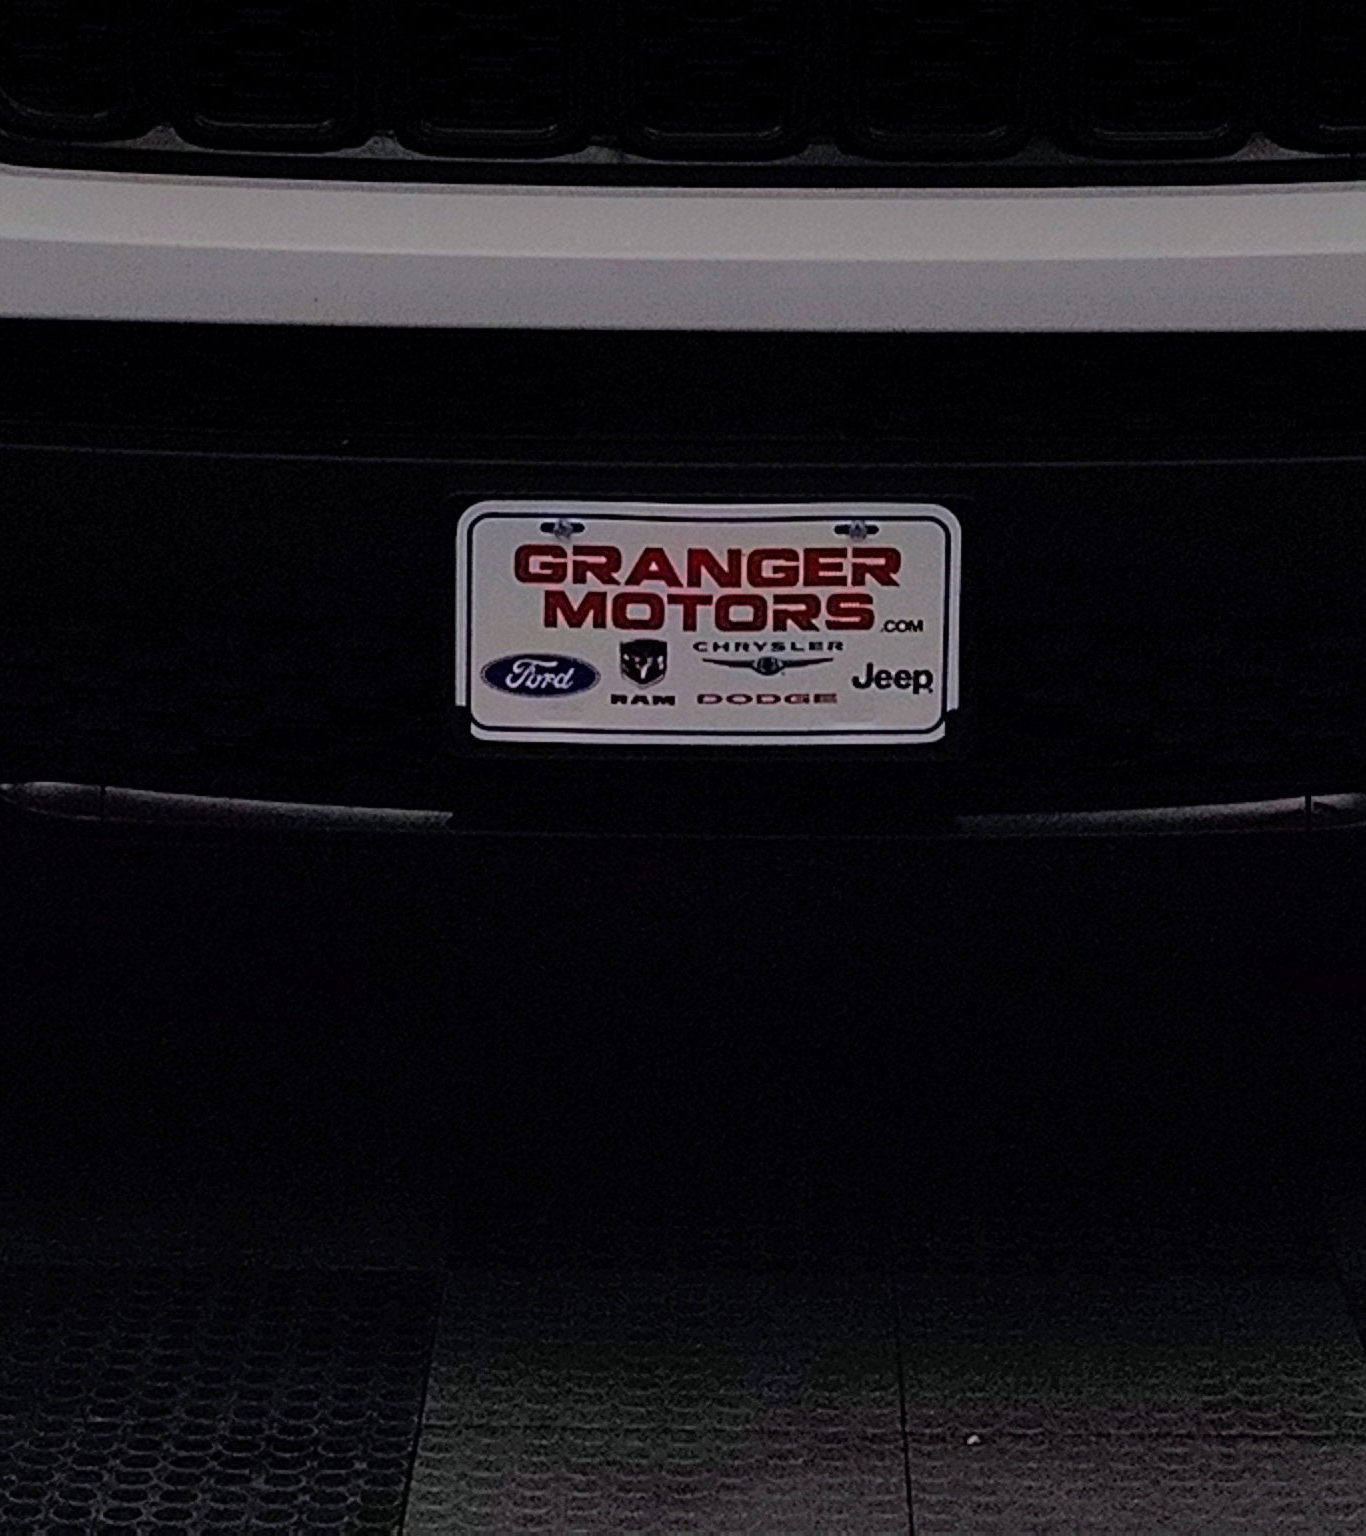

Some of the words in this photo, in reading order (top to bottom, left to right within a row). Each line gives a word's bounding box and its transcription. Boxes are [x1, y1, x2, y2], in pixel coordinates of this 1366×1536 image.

[514, 544, 902, 588] GRANGER
[543, 590, 875, 632] MOTORS
[880, 619, 924, 633] .COM
[692, 641, 844, 652] CHRYSLER
[504, 658, 575, 689] Ford
[851, 662, 934, 695] Jeep
[610, 693, 676, 706] RAM
[697, 693, 838, 705] DODGE
